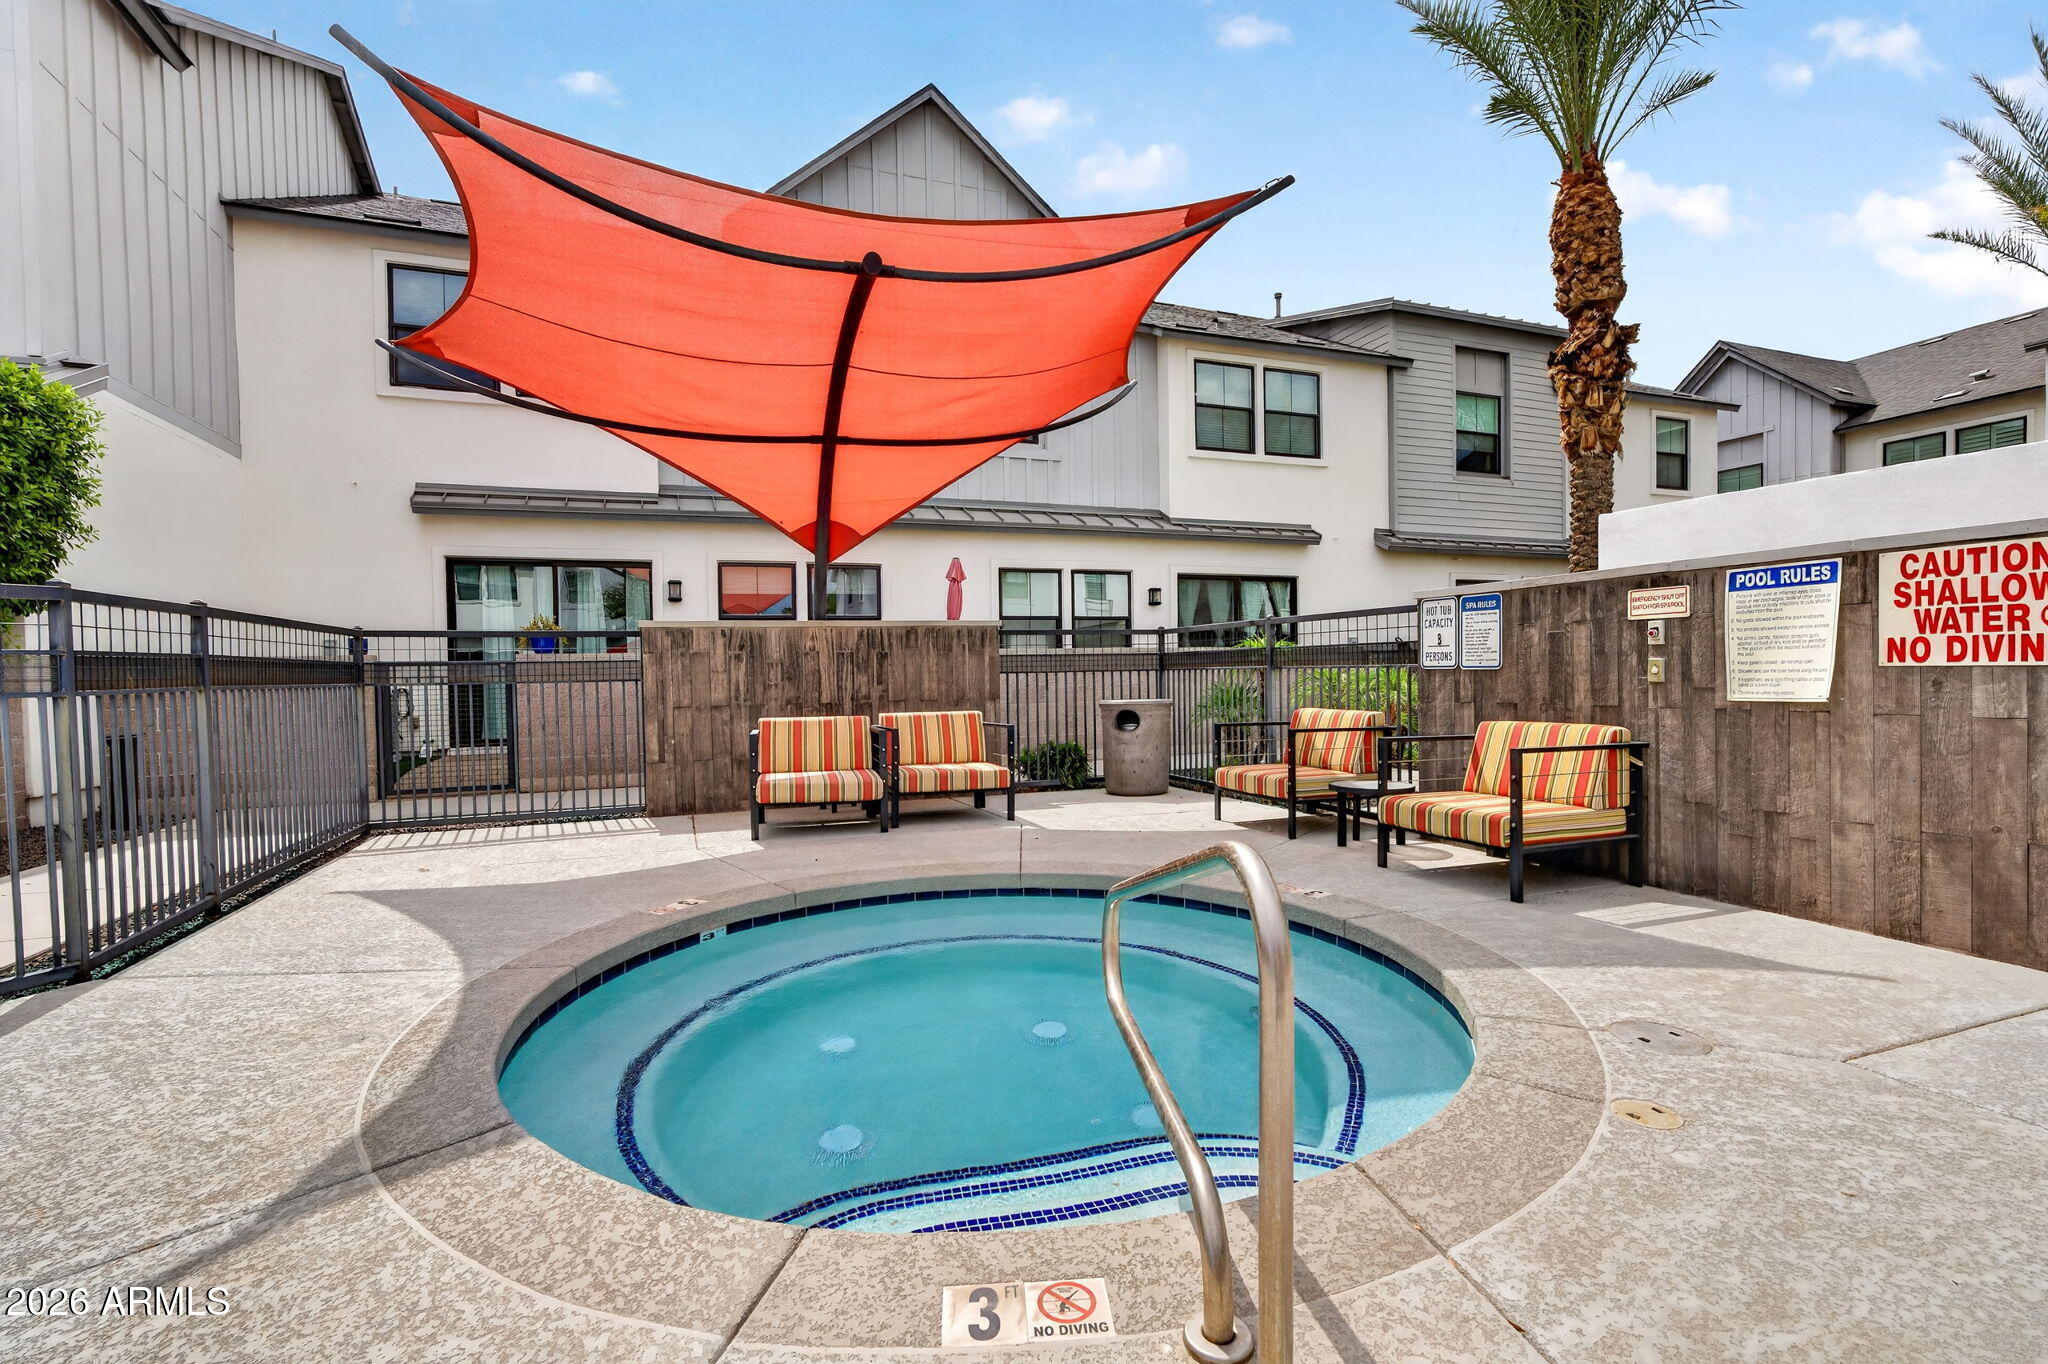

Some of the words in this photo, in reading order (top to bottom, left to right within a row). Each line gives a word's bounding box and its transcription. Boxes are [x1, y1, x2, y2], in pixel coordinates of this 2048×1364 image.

[1900, 542, 2048, 580] CAUTION
[1736, 571, 1775, 588] POOL
[1780, 565, 1831, 584] RULES
[1426, 606, 1438, 616] HOT
[1440, 606, 1451, 615] TUB
[1465, 601, 1477, 609] SPA
[1478, 600, 1497, 608] RULES
[1424, 618, 1454, 628] CAPACITY
[1914, 604, 2030, 634] WATER
[1425, 652, 1452, 661] PERSONS
[1887, 637, 1931, 663] NO
[1947, 633, 2044, 662] DIVIN
[968, 1287, 1001, 1341] 3
[1004, 1285, 1019, 1298] FT
[1034, 1326, 1054, 1337] NO
[1059, 1322, 1109, 1335] DIVING
